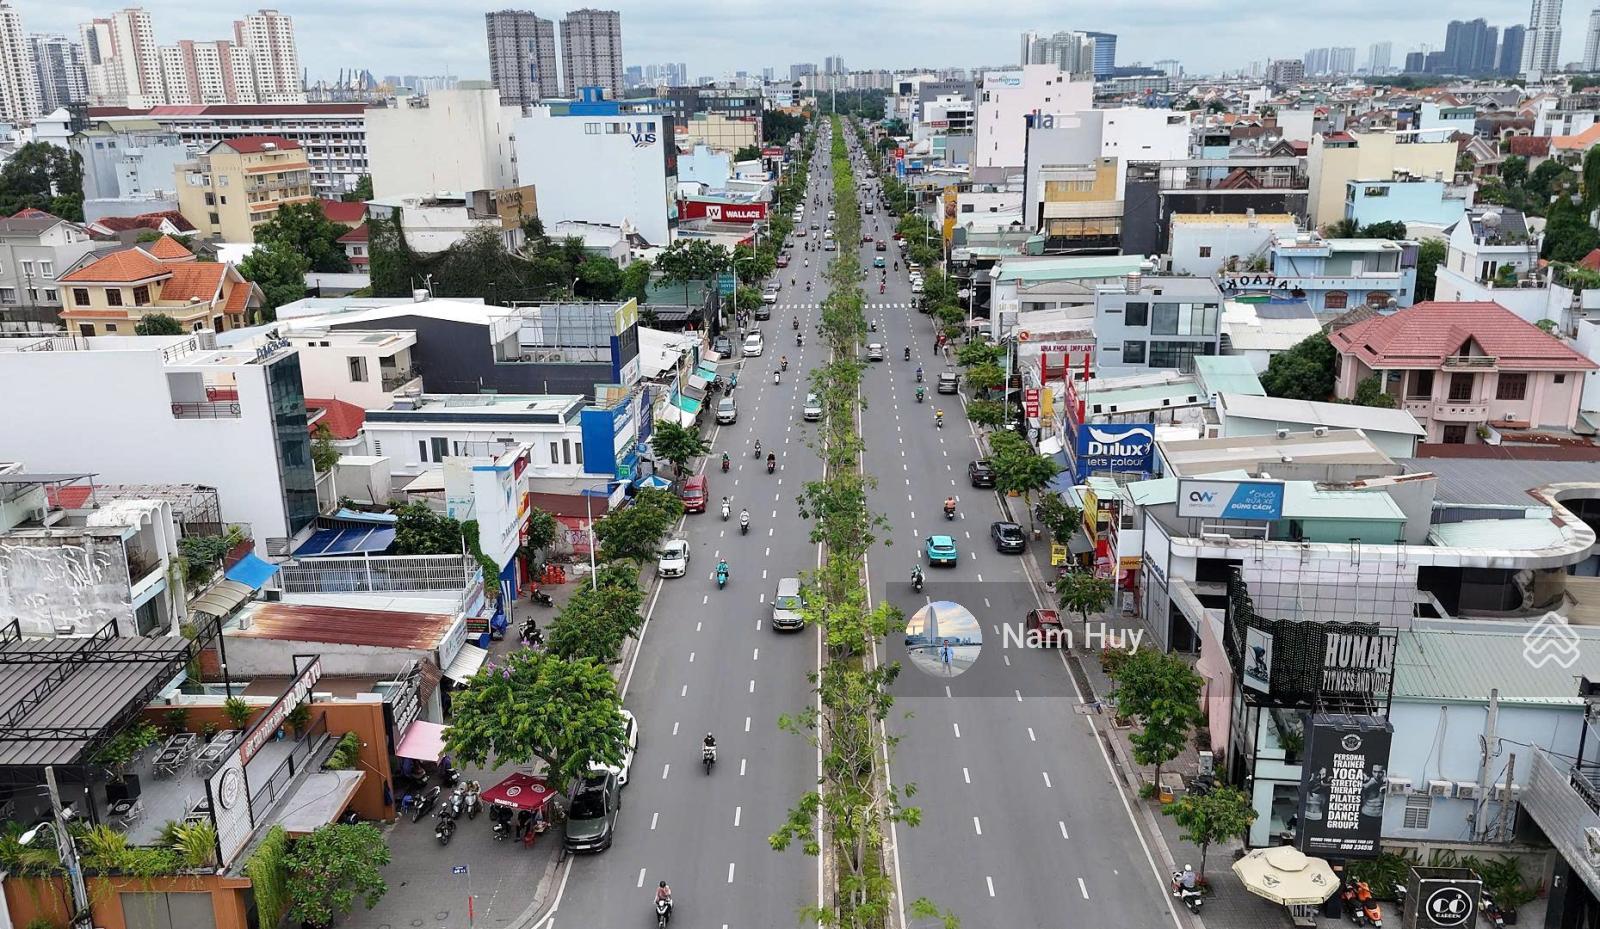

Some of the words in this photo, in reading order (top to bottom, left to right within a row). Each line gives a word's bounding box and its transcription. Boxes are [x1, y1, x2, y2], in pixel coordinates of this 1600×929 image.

[726, 210, 761, 219] WALLACE
[1087, 441, 1143, 457] Dulux
[1111, 459, 1144, 468] colour
[1324, 632, 1395, 669] HUMAN
[1333, 753, 1366, 762] PERSONAL
[1333, 760, 1365, 769] TRAINER
[1332, 768, 1364, 780] YOGA
[1331, 779, 1363, 788] STRETCH
[1330, 786, 1362, 795] THERAPY
[1329, 794, 1362, 803] PILATES
[1328, 802, 1361, 812] KICKFIT
[1327, 811, 1359, 822] DANCE
[1327, 820, 1359, 830] GROUPX
